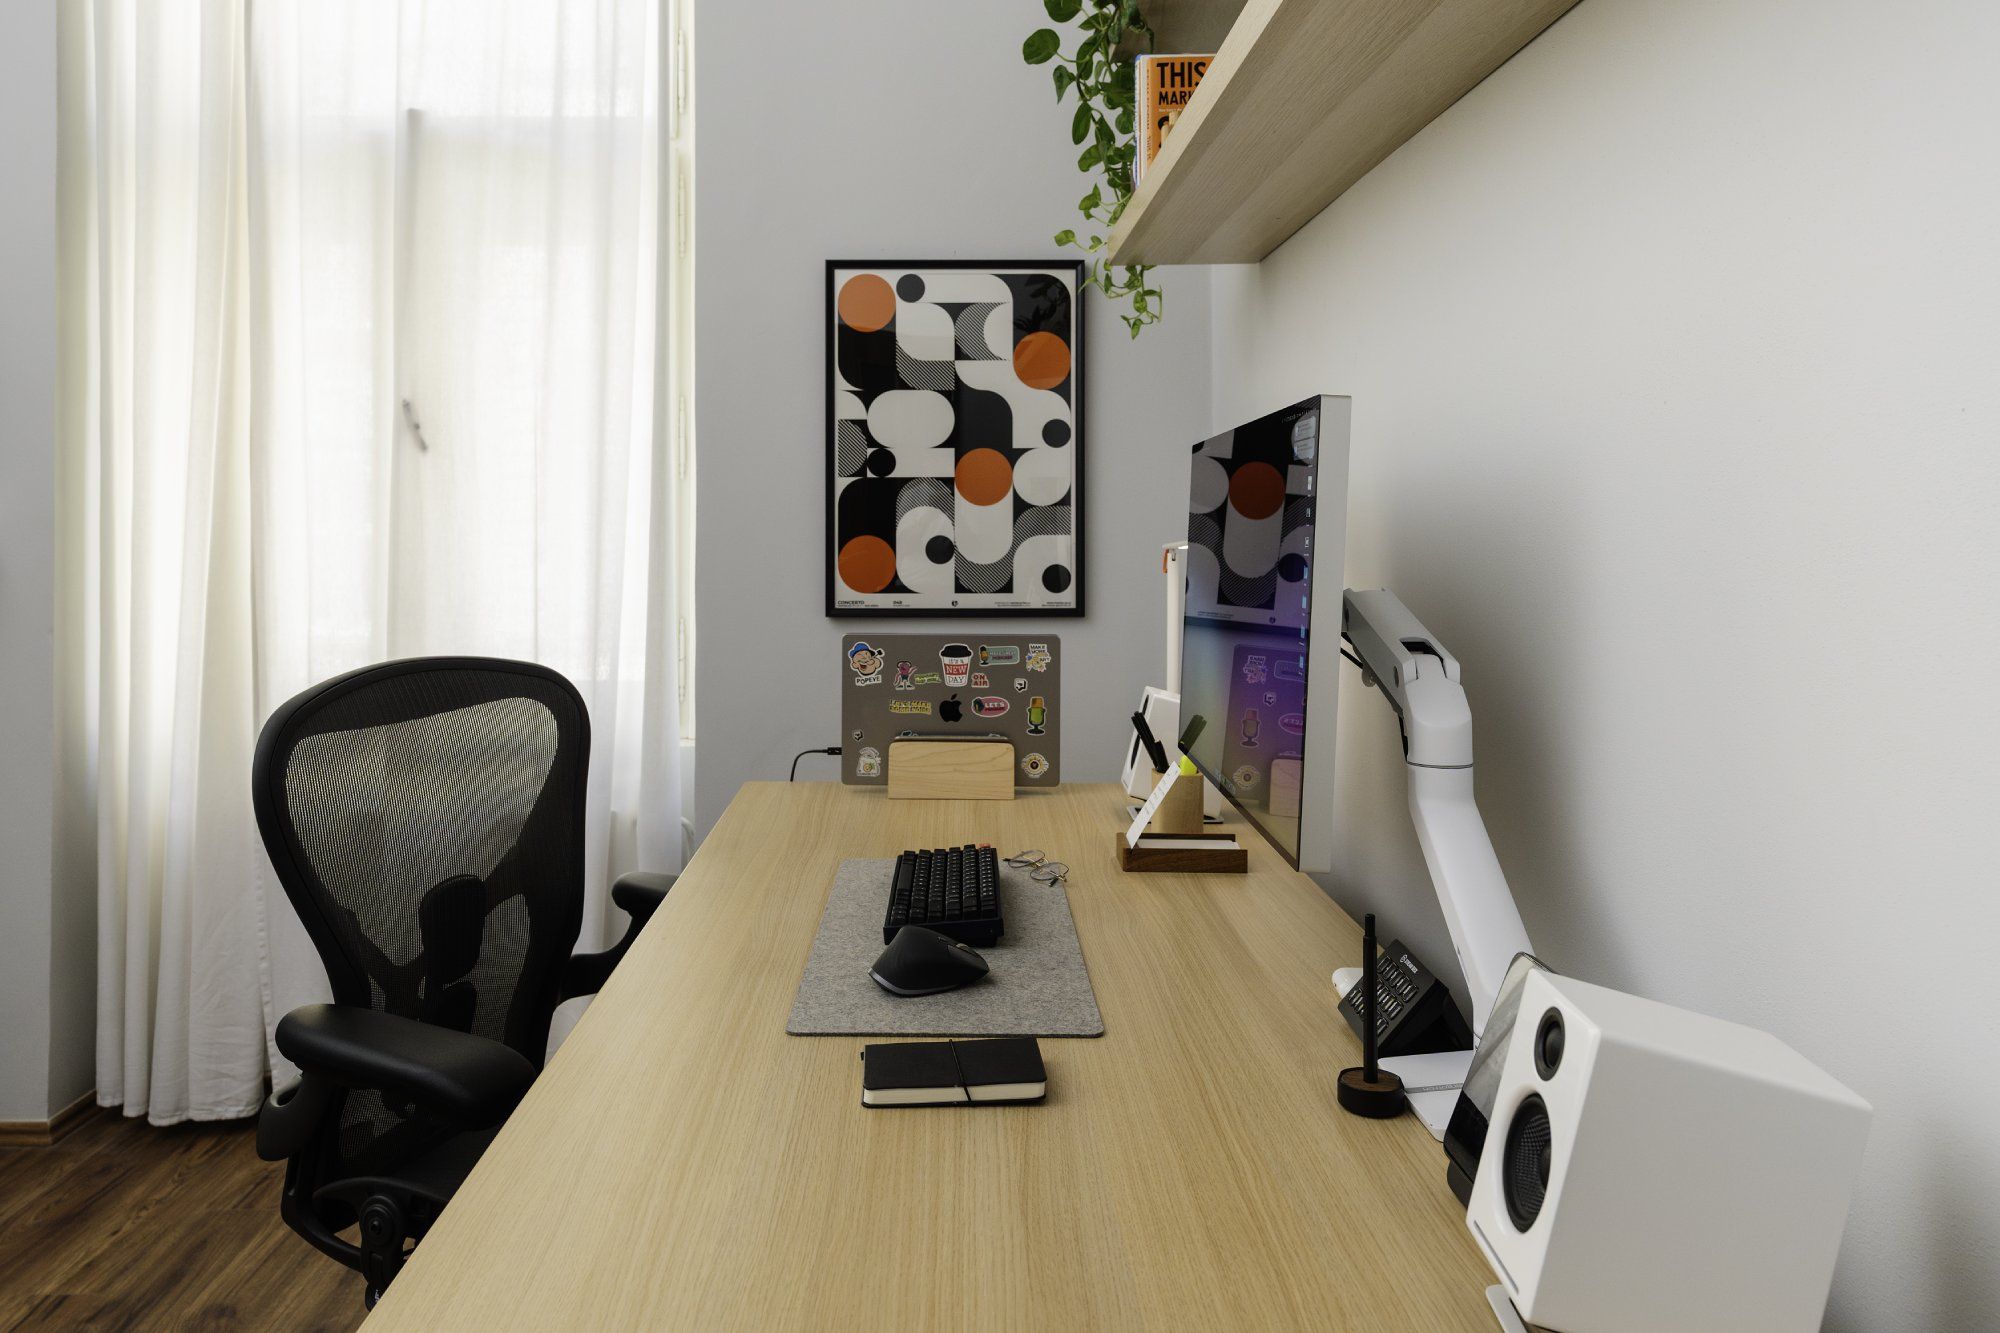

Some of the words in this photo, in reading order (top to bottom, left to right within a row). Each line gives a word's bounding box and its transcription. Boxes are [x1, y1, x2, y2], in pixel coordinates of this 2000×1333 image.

[1156, 61, 1207, 89] THIS
[946, 665, 967, 674] NEW
[856, 676, 881, 685] POPEYE
[947, 675, 966, 683] DAY
